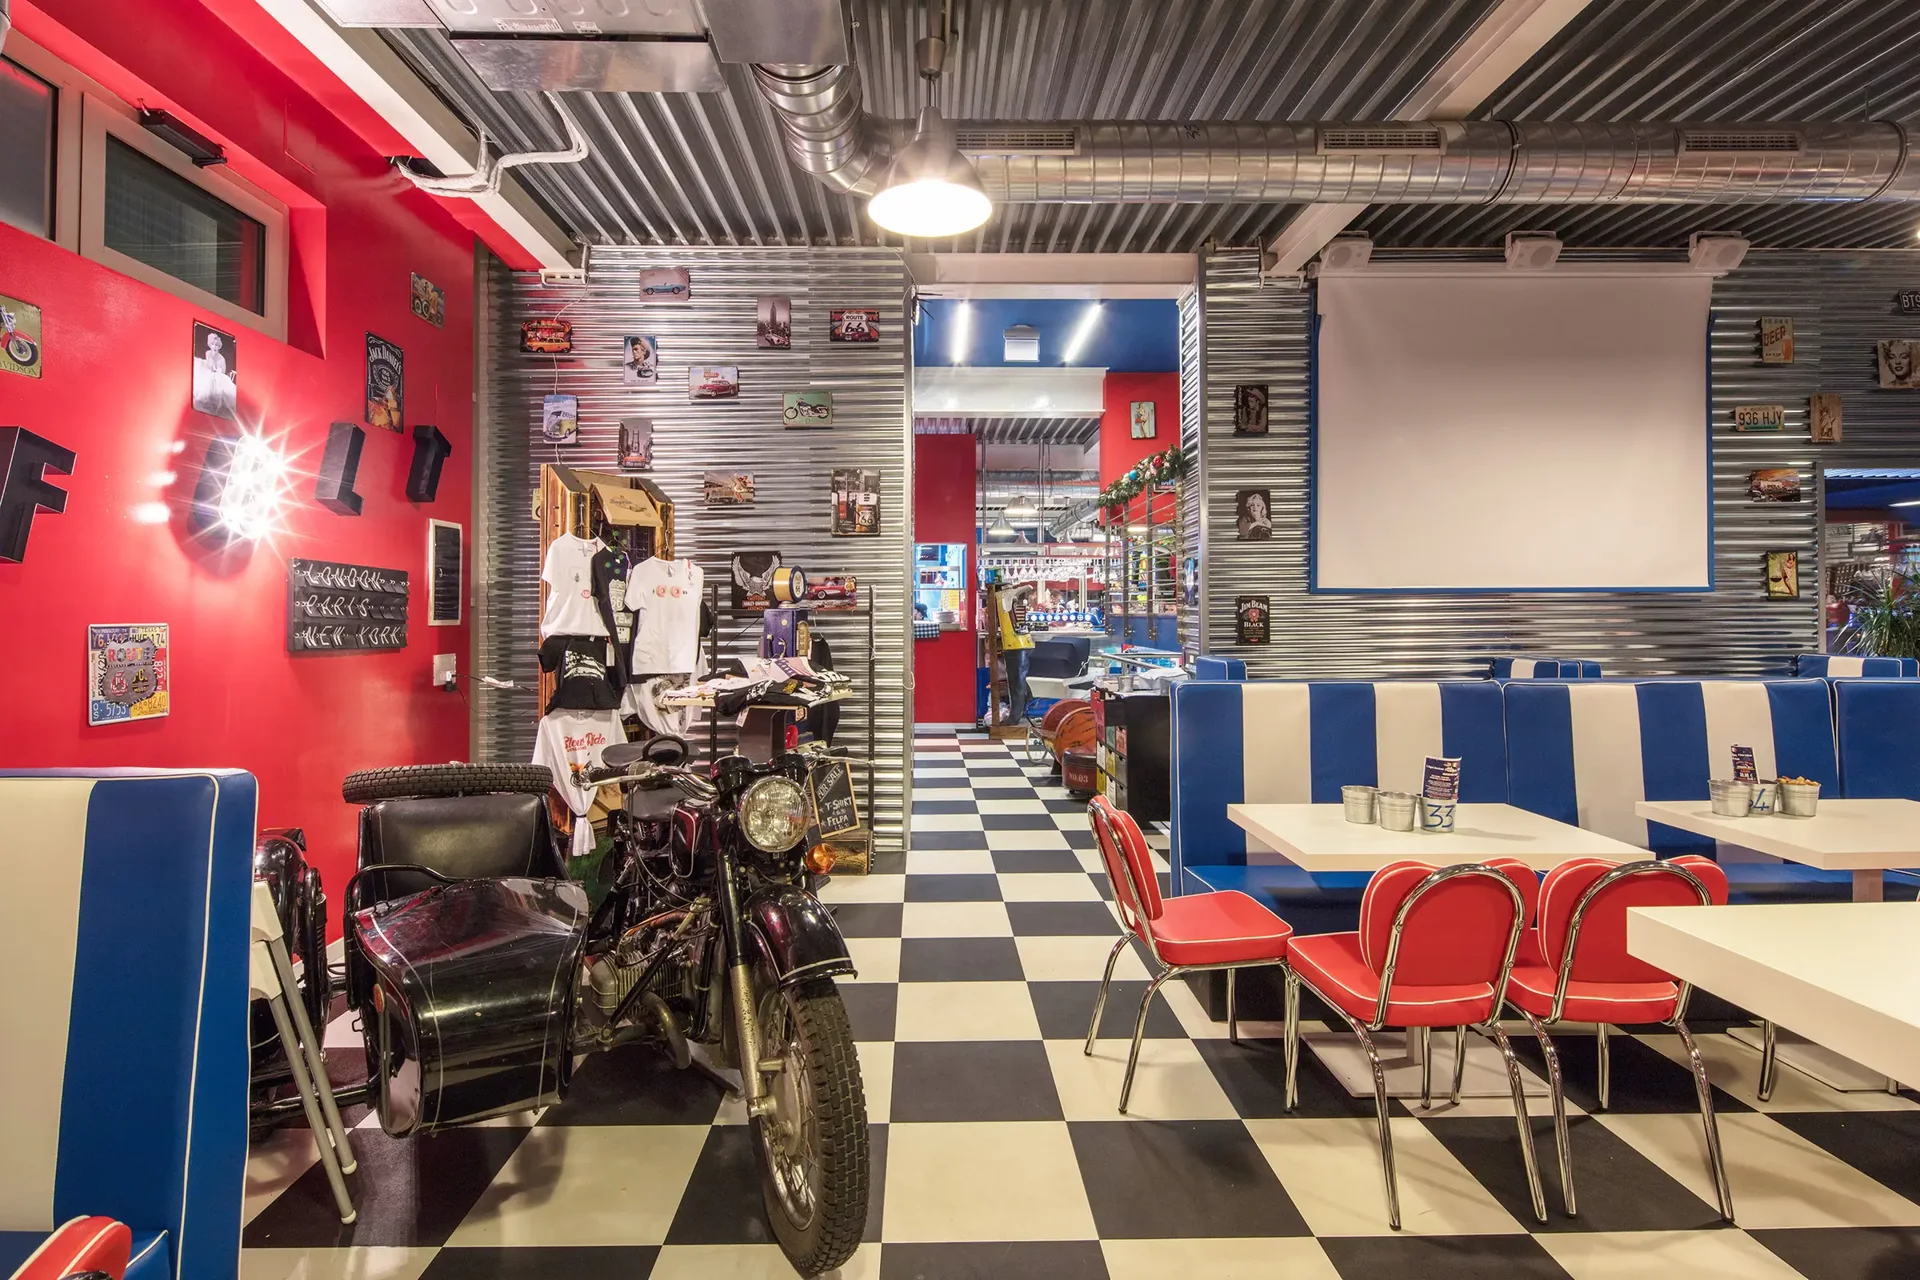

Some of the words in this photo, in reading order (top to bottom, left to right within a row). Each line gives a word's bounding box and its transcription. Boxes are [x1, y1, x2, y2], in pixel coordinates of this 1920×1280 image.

[1739, 411, 1758, 425] 936
[1762, 410, 1782, 425] HJY
[307, 564, 381, 590] LONDON
[306, 595, 369, 617] PARIS
[1240, 602, 1251, 613] JIM
[1251, 600, 1268, 612] BEAM
[305, 626, 345, 647] NEW
[360, 626, 400, 645] YORK
[107, 647, 151, 663] ROUTE
[586, 732, 606, 747] Ride
[826, 765, 845, 787] SALE
[825, 796, 852, 811] T-SHIRT
[827, 814, 849, 827] FELPA
[1424, 803, 1456, 829] 33
